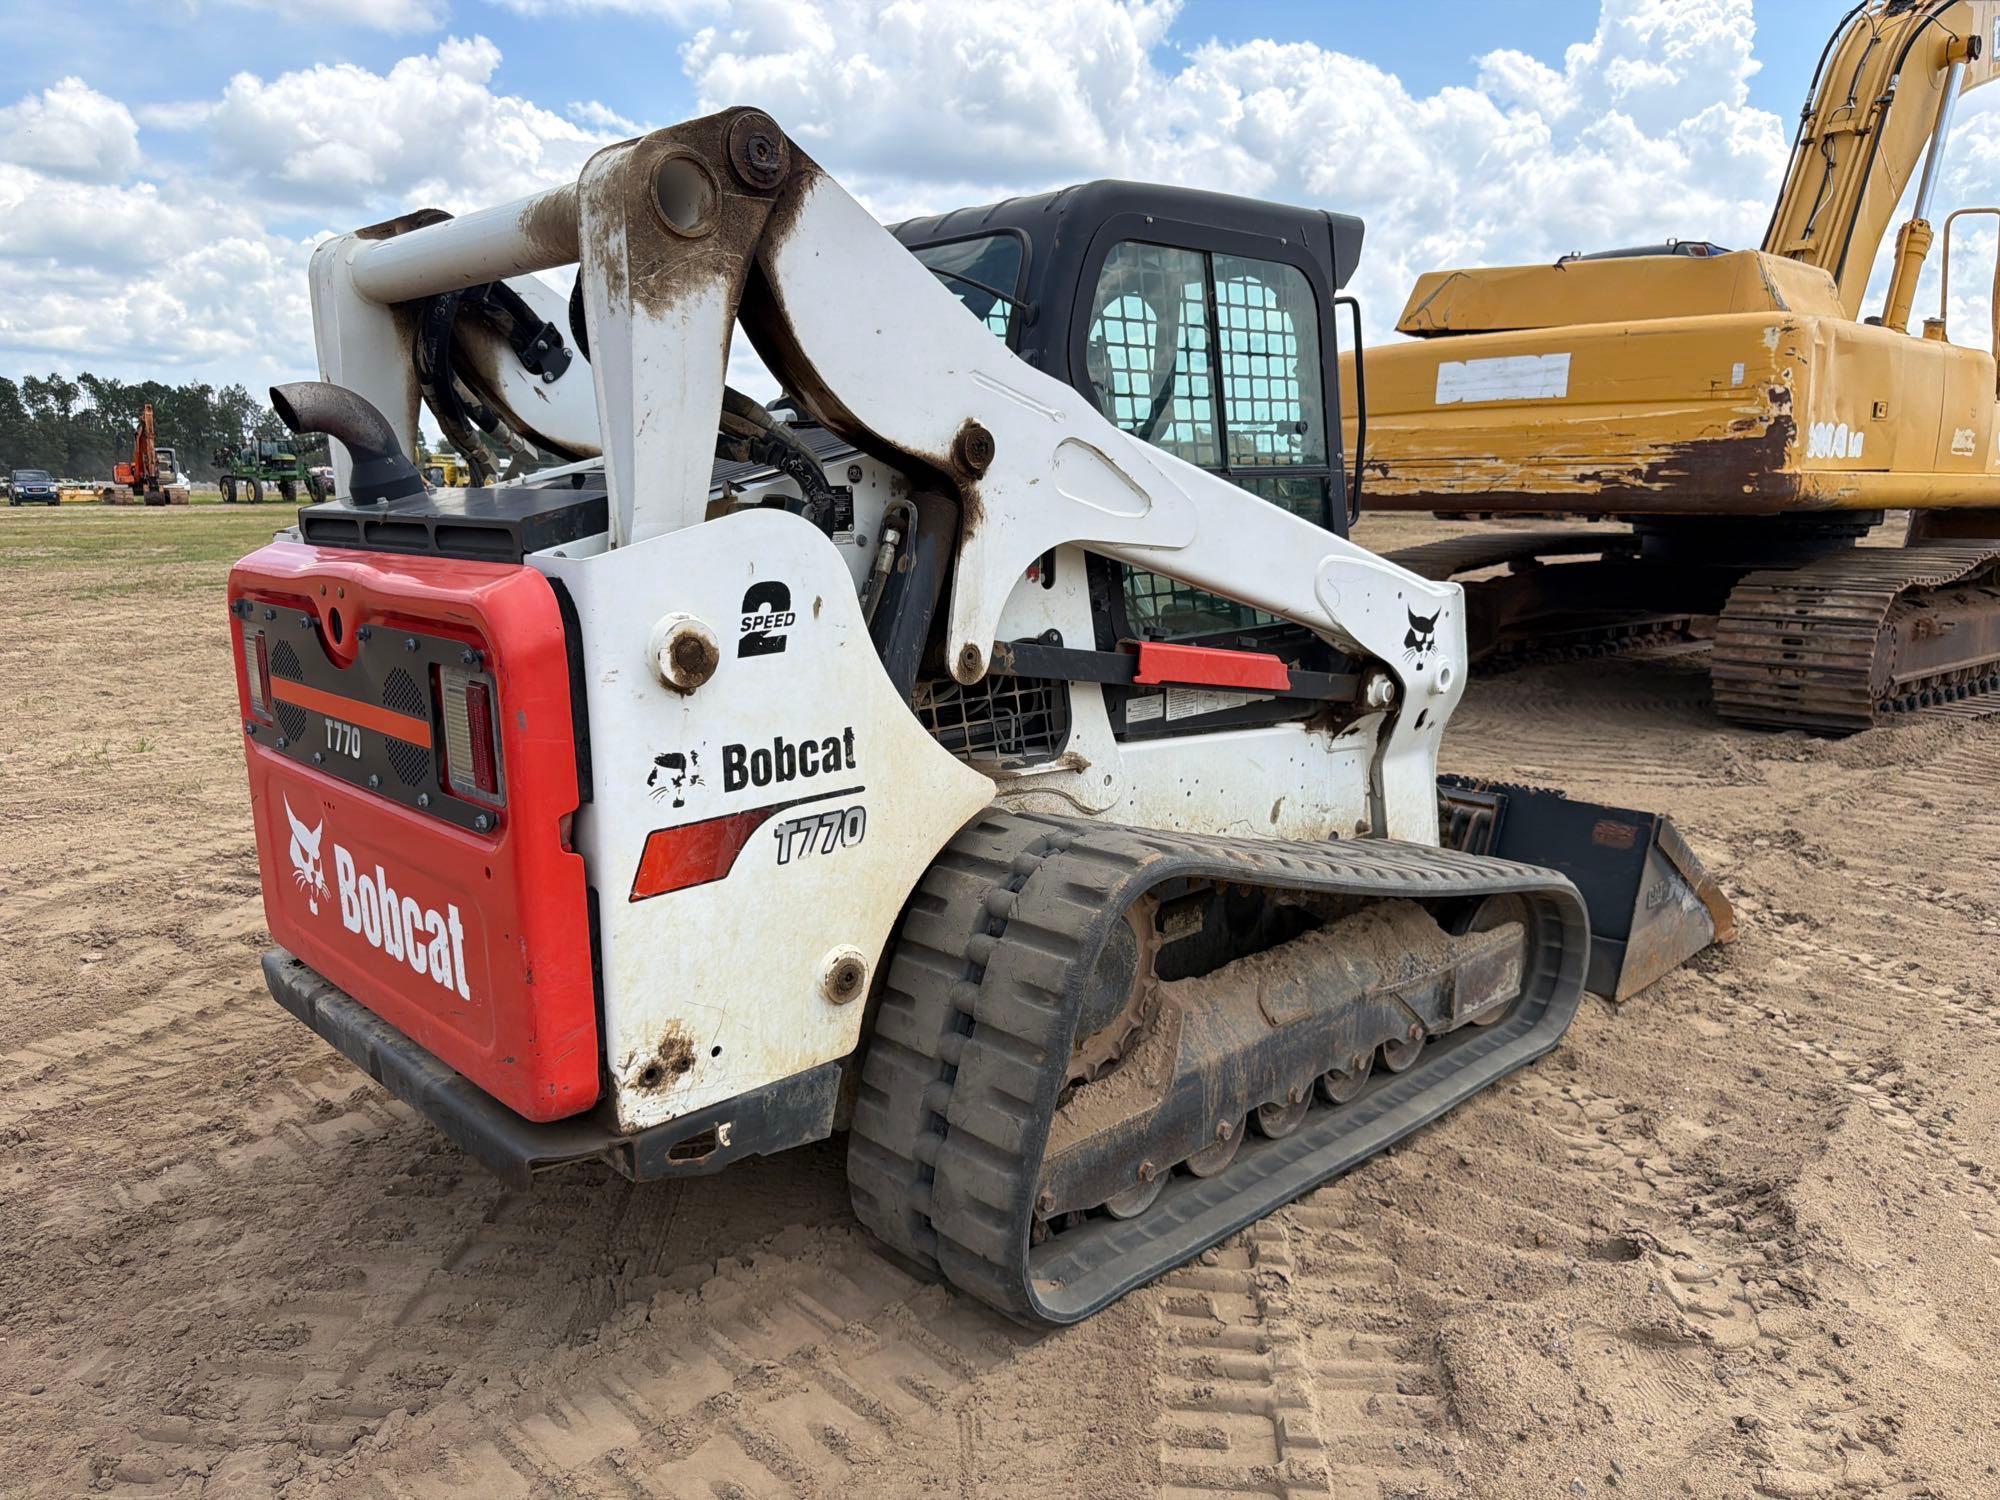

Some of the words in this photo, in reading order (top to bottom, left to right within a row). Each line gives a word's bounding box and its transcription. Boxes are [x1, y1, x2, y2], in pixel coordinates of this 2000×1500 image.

[737, 580, 791, 659] 2
[740, 612, 796, 632] SPEED
[325, 718, 361, 759] T770
[722, 726, 856, 793] Bobcat
[774, 805, 866, 865] T770
[333, 843, 471, 1001] Bobcat
